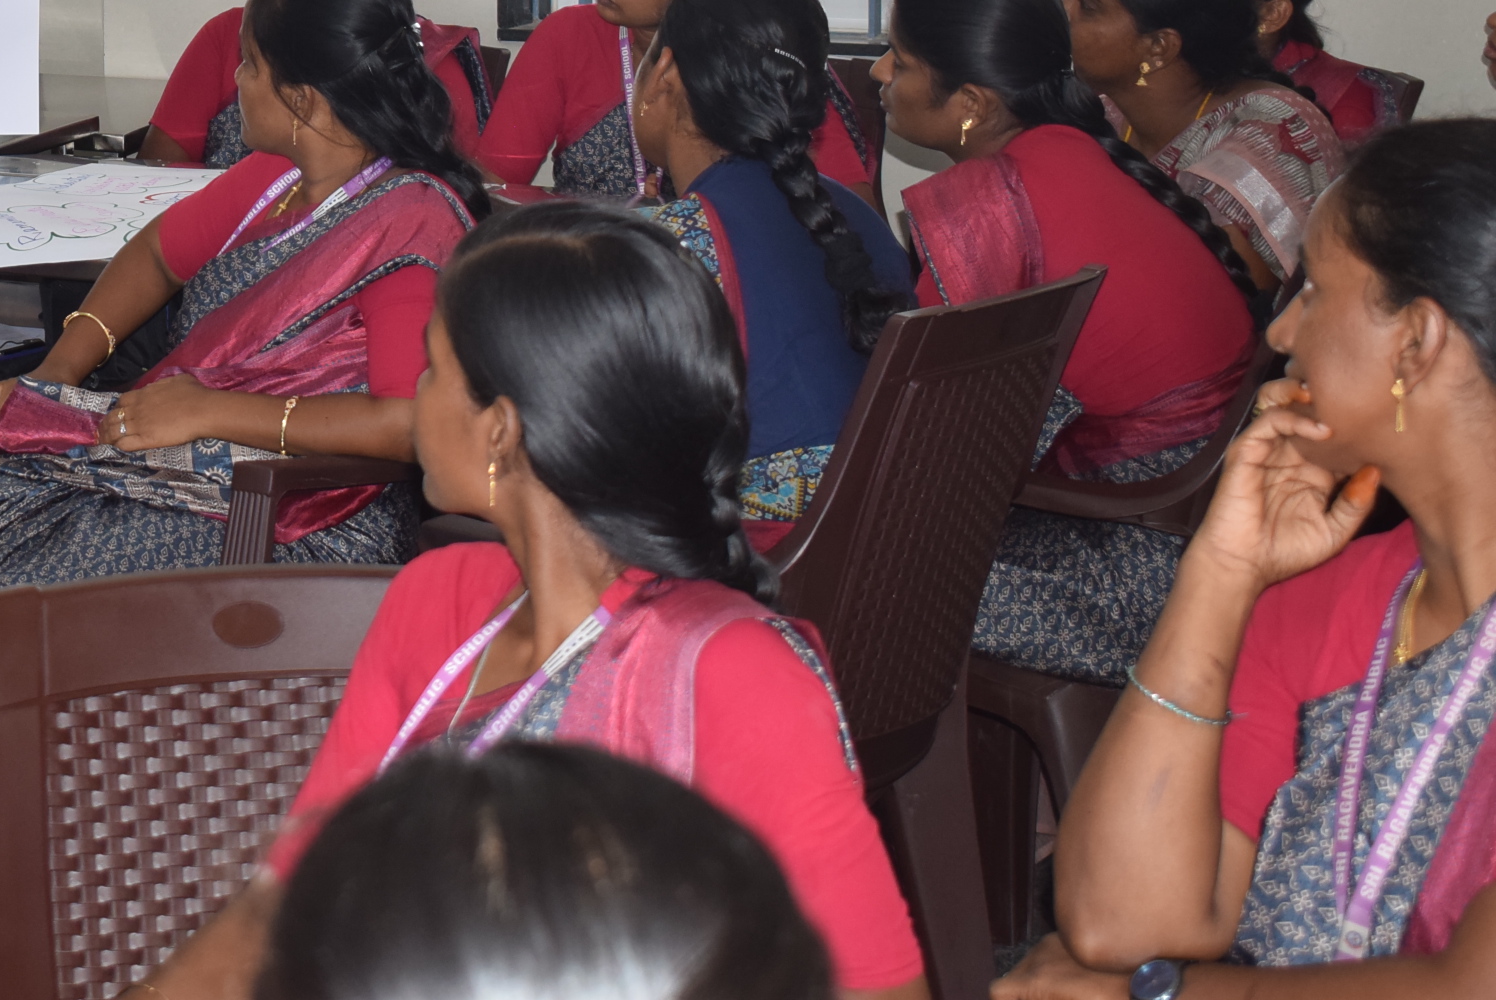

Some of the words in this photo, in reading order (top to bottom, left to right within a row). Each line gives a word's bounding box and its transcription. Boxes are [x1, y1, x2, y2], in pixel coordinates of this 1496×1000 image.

[620, 43, 632, 81] SCHOOL
[237, 197, 267, 232] PUBLIC
[398, 677, 444, 739] PUBLIC
[443, 618, 503, 675] SCHOOL
[1360, 636, 1389, 702] PUBLIC
[482, 682, 538, 741] SCHOOL
[1336, 709, 1370, 842] RAGAVENDRA
[1359, 865, 1385, 901] SRI
[1376, 732, 1446, 860] RAGAVENDRA
[1443, 655, 1488, 726] PUBLIC
[1335, 851, 1348, 885] SRI
